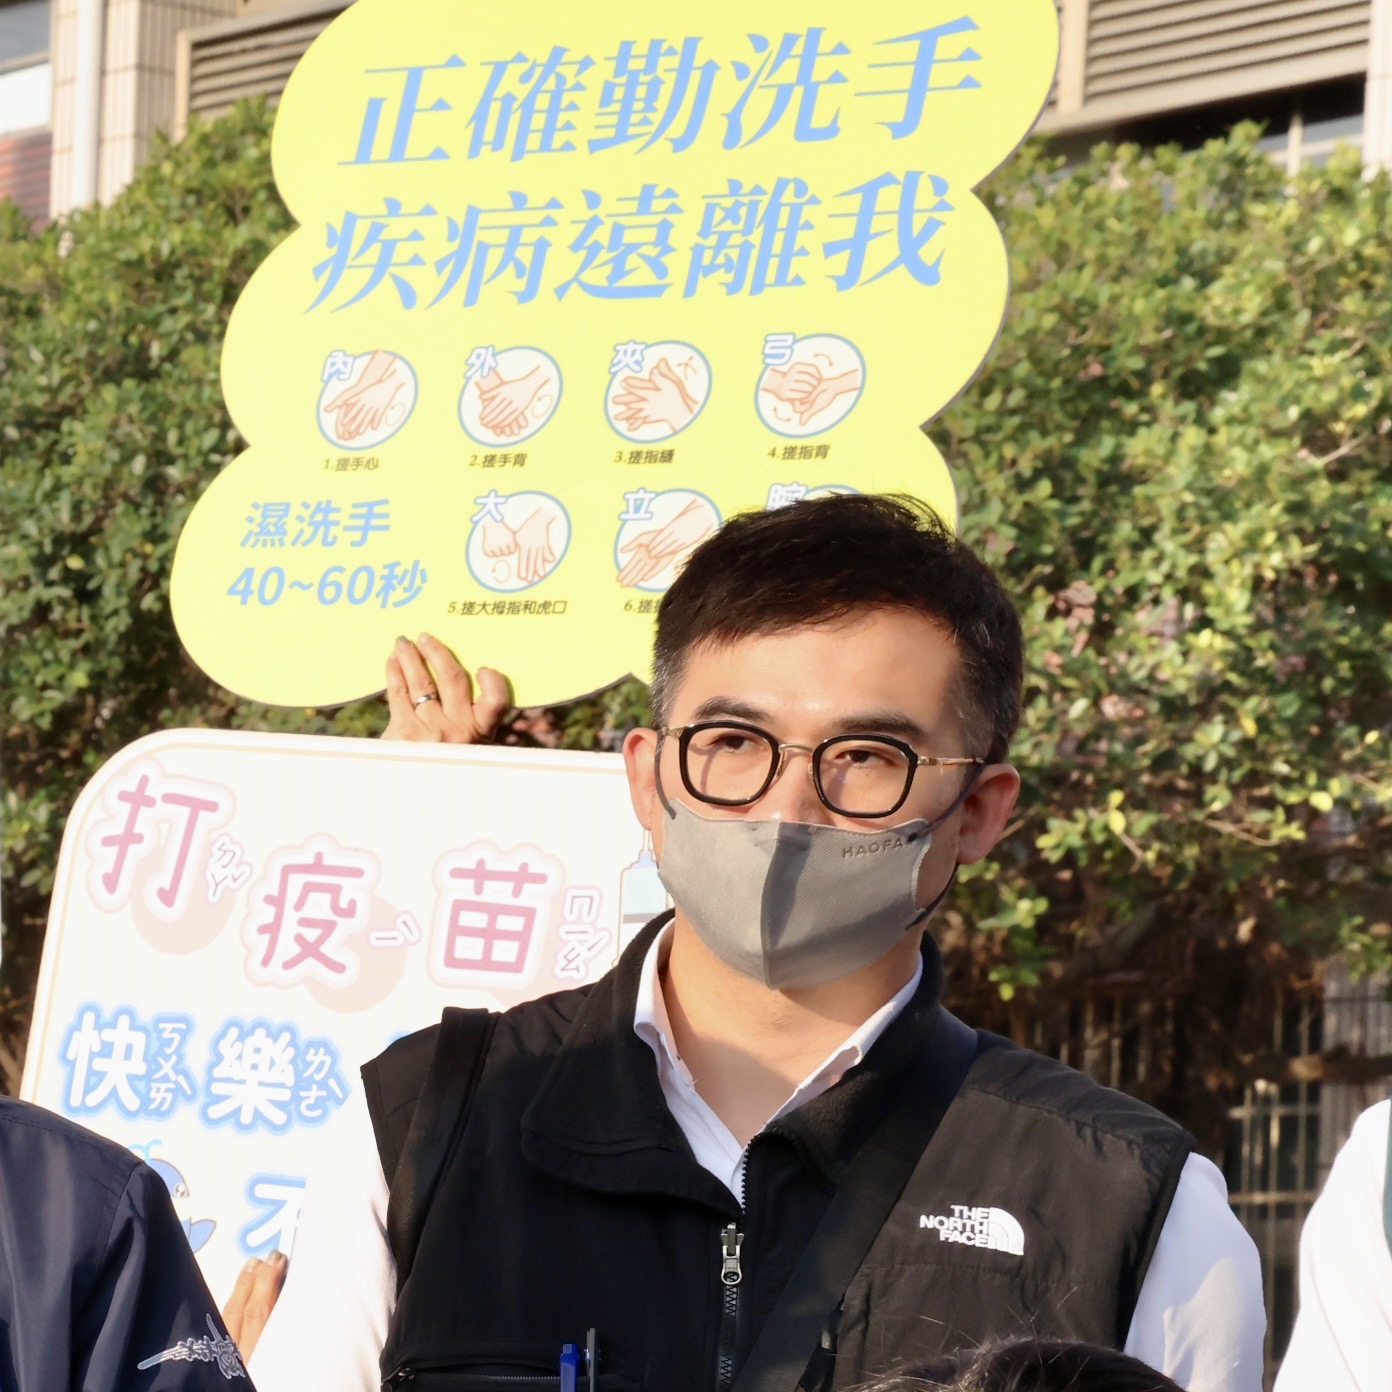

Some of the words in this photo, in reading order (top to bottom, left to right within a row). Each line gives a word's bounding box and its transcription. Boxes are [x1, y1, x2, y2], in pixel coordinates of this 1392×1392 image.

[337, 15, 983, 167] 正確勤洗手
[303, 169, 955, 315] 疾病遠離我
[464, 345, 497, 378] 外
[609, 340, 647, 373] 夾
[763, 332, 796, 365] 弓
[469, 490, 506, 523] 大
[620, 488, 656, 520] 立
[226, 560, 428, 609] 40~60秒
[100, 775, 549, 974] 打疫苗
[919, 1215, 988, 1235] NORTH
[950, 1204, 989, 1220] THE
[939, 1230, 989, 1248] FACE
